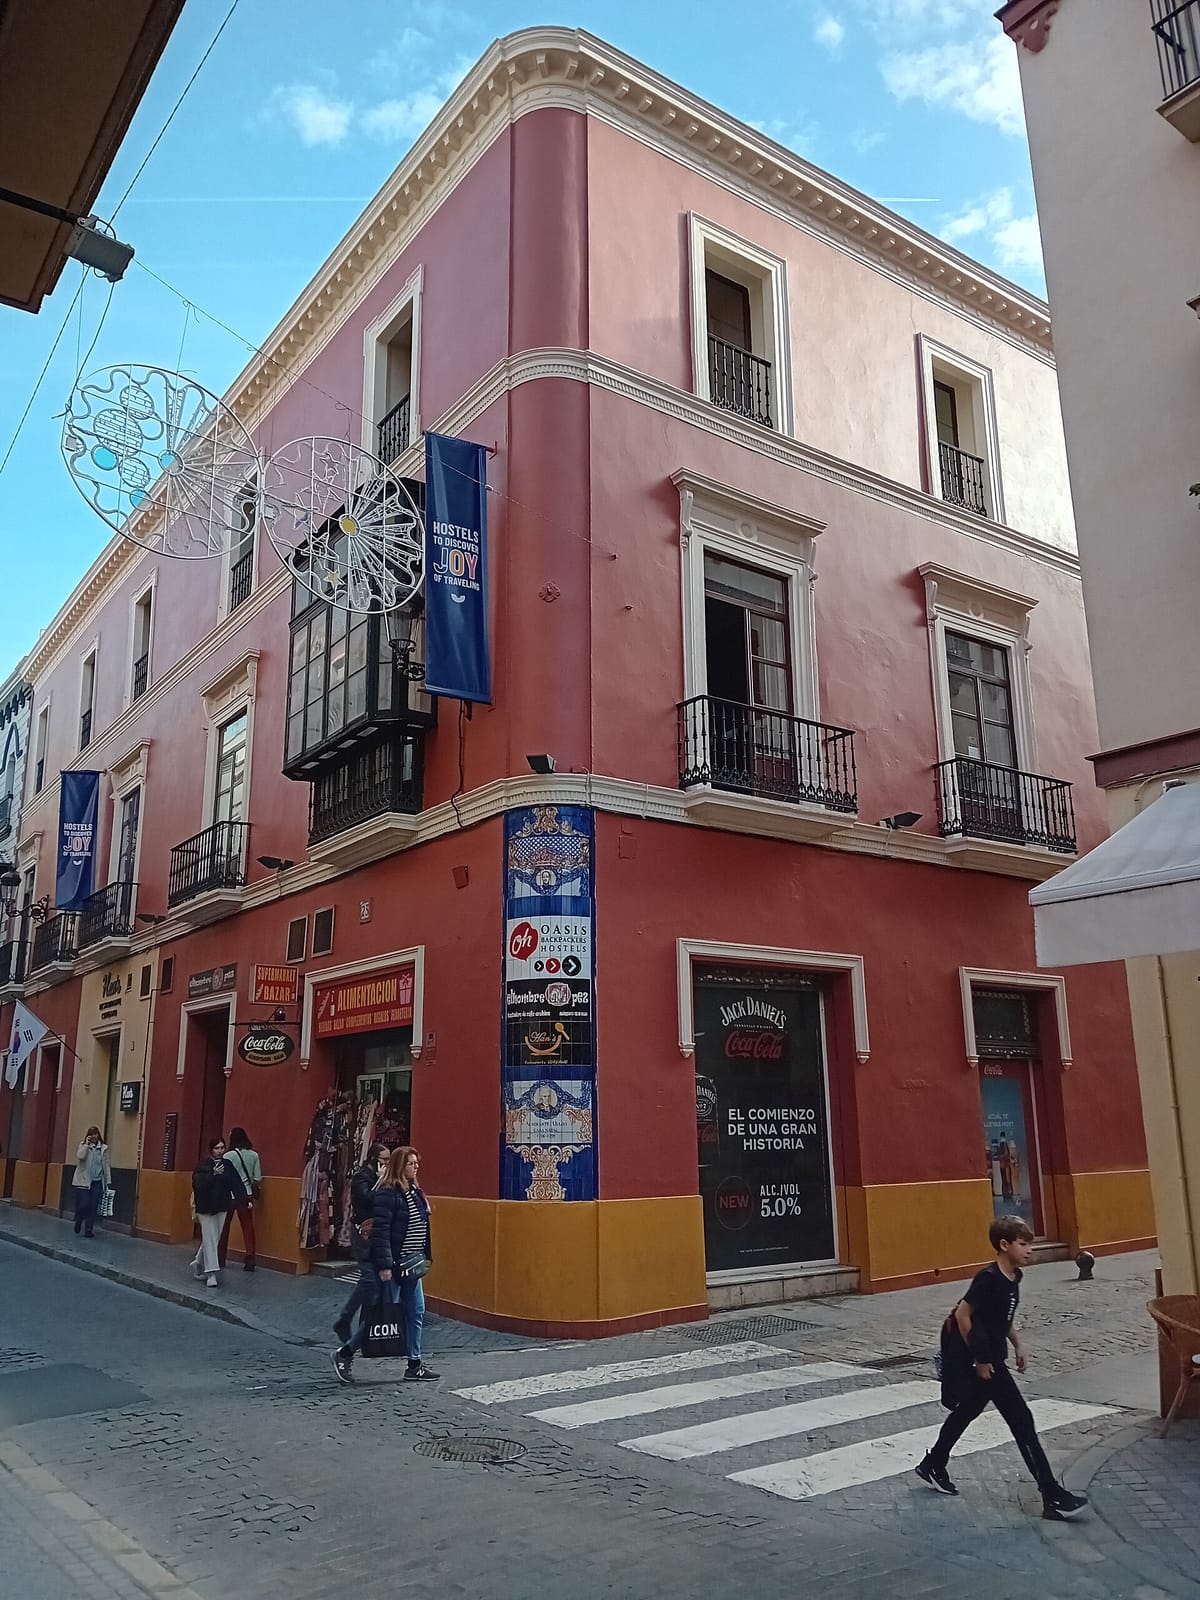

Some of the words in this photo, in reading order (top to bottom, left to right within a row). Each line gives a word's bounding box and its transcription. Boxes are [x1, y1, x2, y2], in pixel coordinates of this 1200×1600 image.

[433, 521, 479, 543] HOSTELS
[433, 535, 443, 545] TO
[445, 537, 479, 555] DISCOVER
[433, 547, 478, 580] JOY
[433, 573, 442, 583] OF
[443, 575, 480, 591] TRAVELING
[63, 822, 93, 831] HOSTELS
[62, 836, 92, 852] JOY
[540, 924, 587, 936] OASIS
[540, 935, 587, 944] BACKPACKERS
[540, 944, 587, 953] HOSTELS
[257, 966, 297, 984] SUPERMARKET
[263, 985, 291, 1001] BAZAR
[337, 978, 397, 1012] ALIMENTACION
[720, 1000, 746, 1026] JACK
[746, 996, 787, 1029] DANIEL'S
[728, 1108, 744, 1120] EL
[748, 1108, 815, 1121] COMIENZO
[728, 1123, 746, 1136] DE
[749, 1123, 778, 1135] UNA
[781, 1123, 817, 1135] GRAN
[743, 1138, 805, 1150] HISTORIA
[719, 1194, 750, 1209] NEW
[760, 1197, 802, 1218] 5.0%
